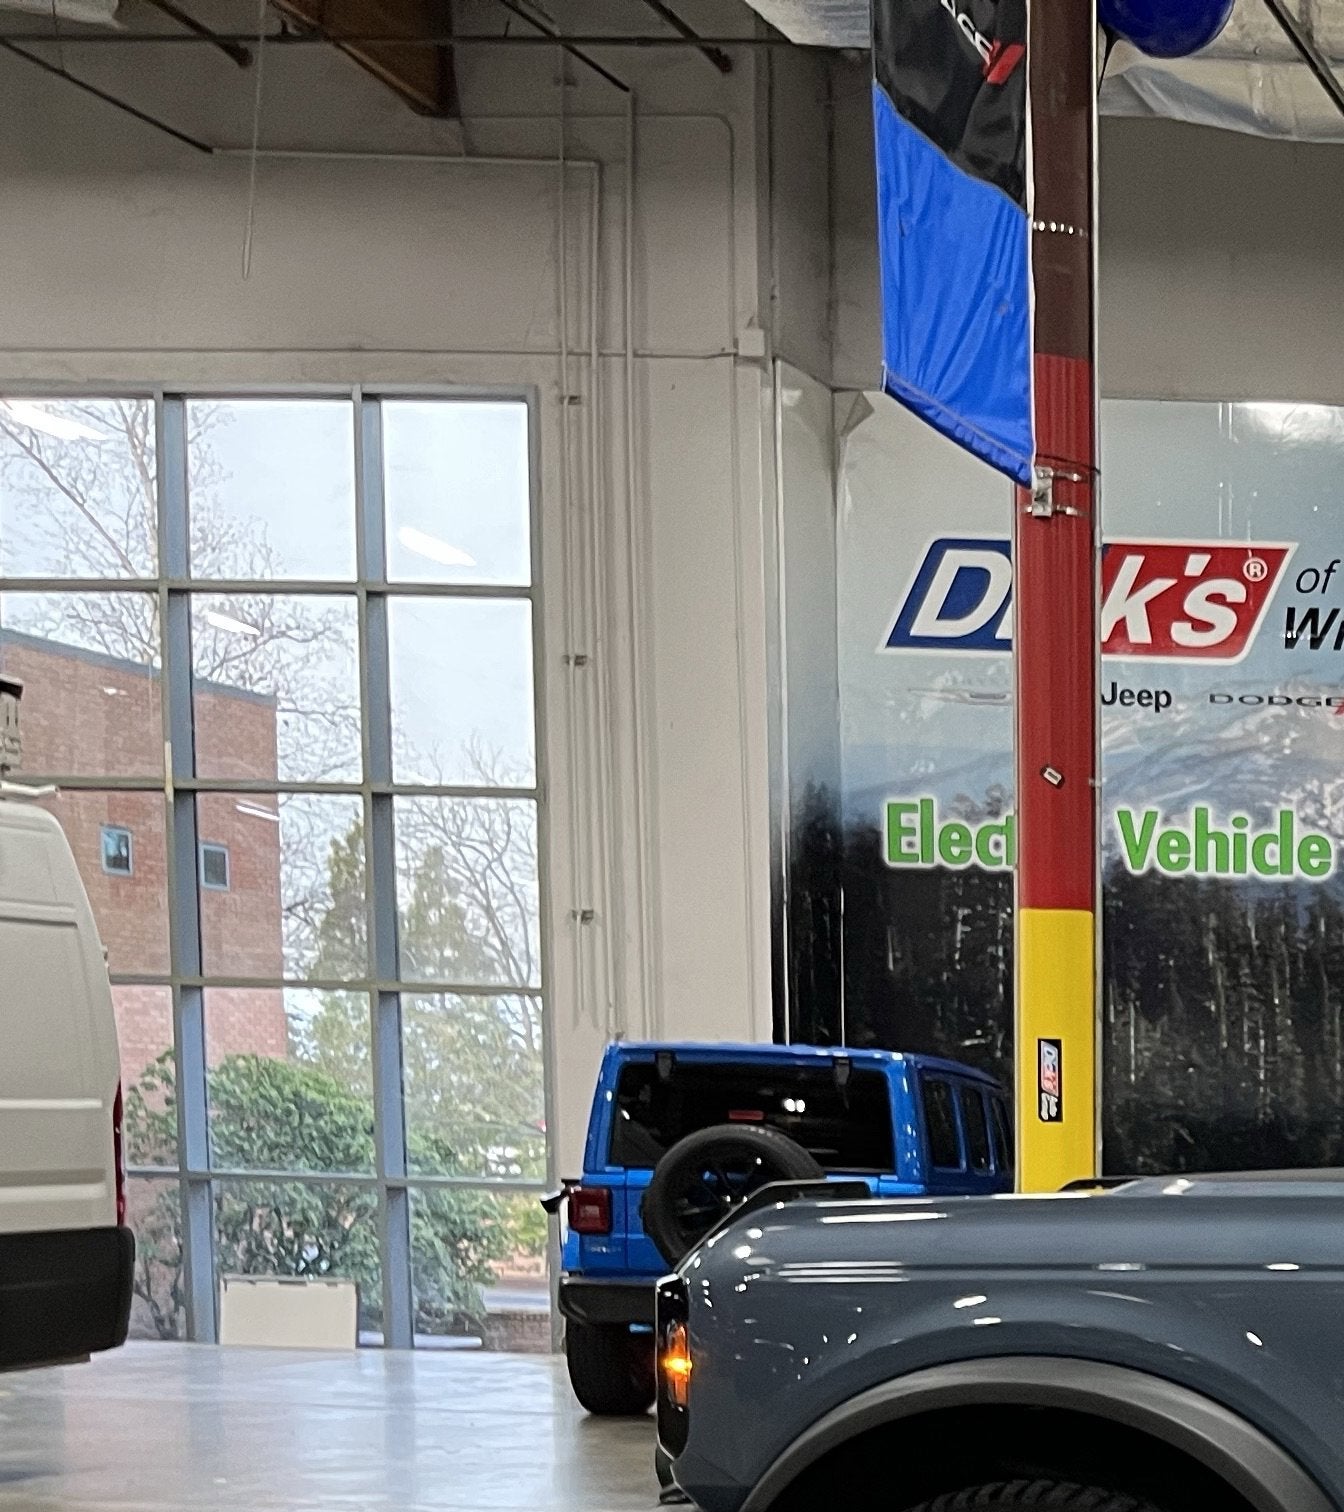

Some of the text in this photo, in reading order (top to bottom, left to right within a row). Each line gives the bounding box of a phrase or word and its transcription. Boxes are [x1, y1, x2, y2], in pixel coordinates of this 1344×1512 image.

[909, 549, 1247, 648] Dk's
[1295, 559, 1341, 594] of
[1101, 681, 1172, 713] Jeep
[886, 798, 1016, 867] Elect
[1117, 807, 1332, 877] Vehicle
